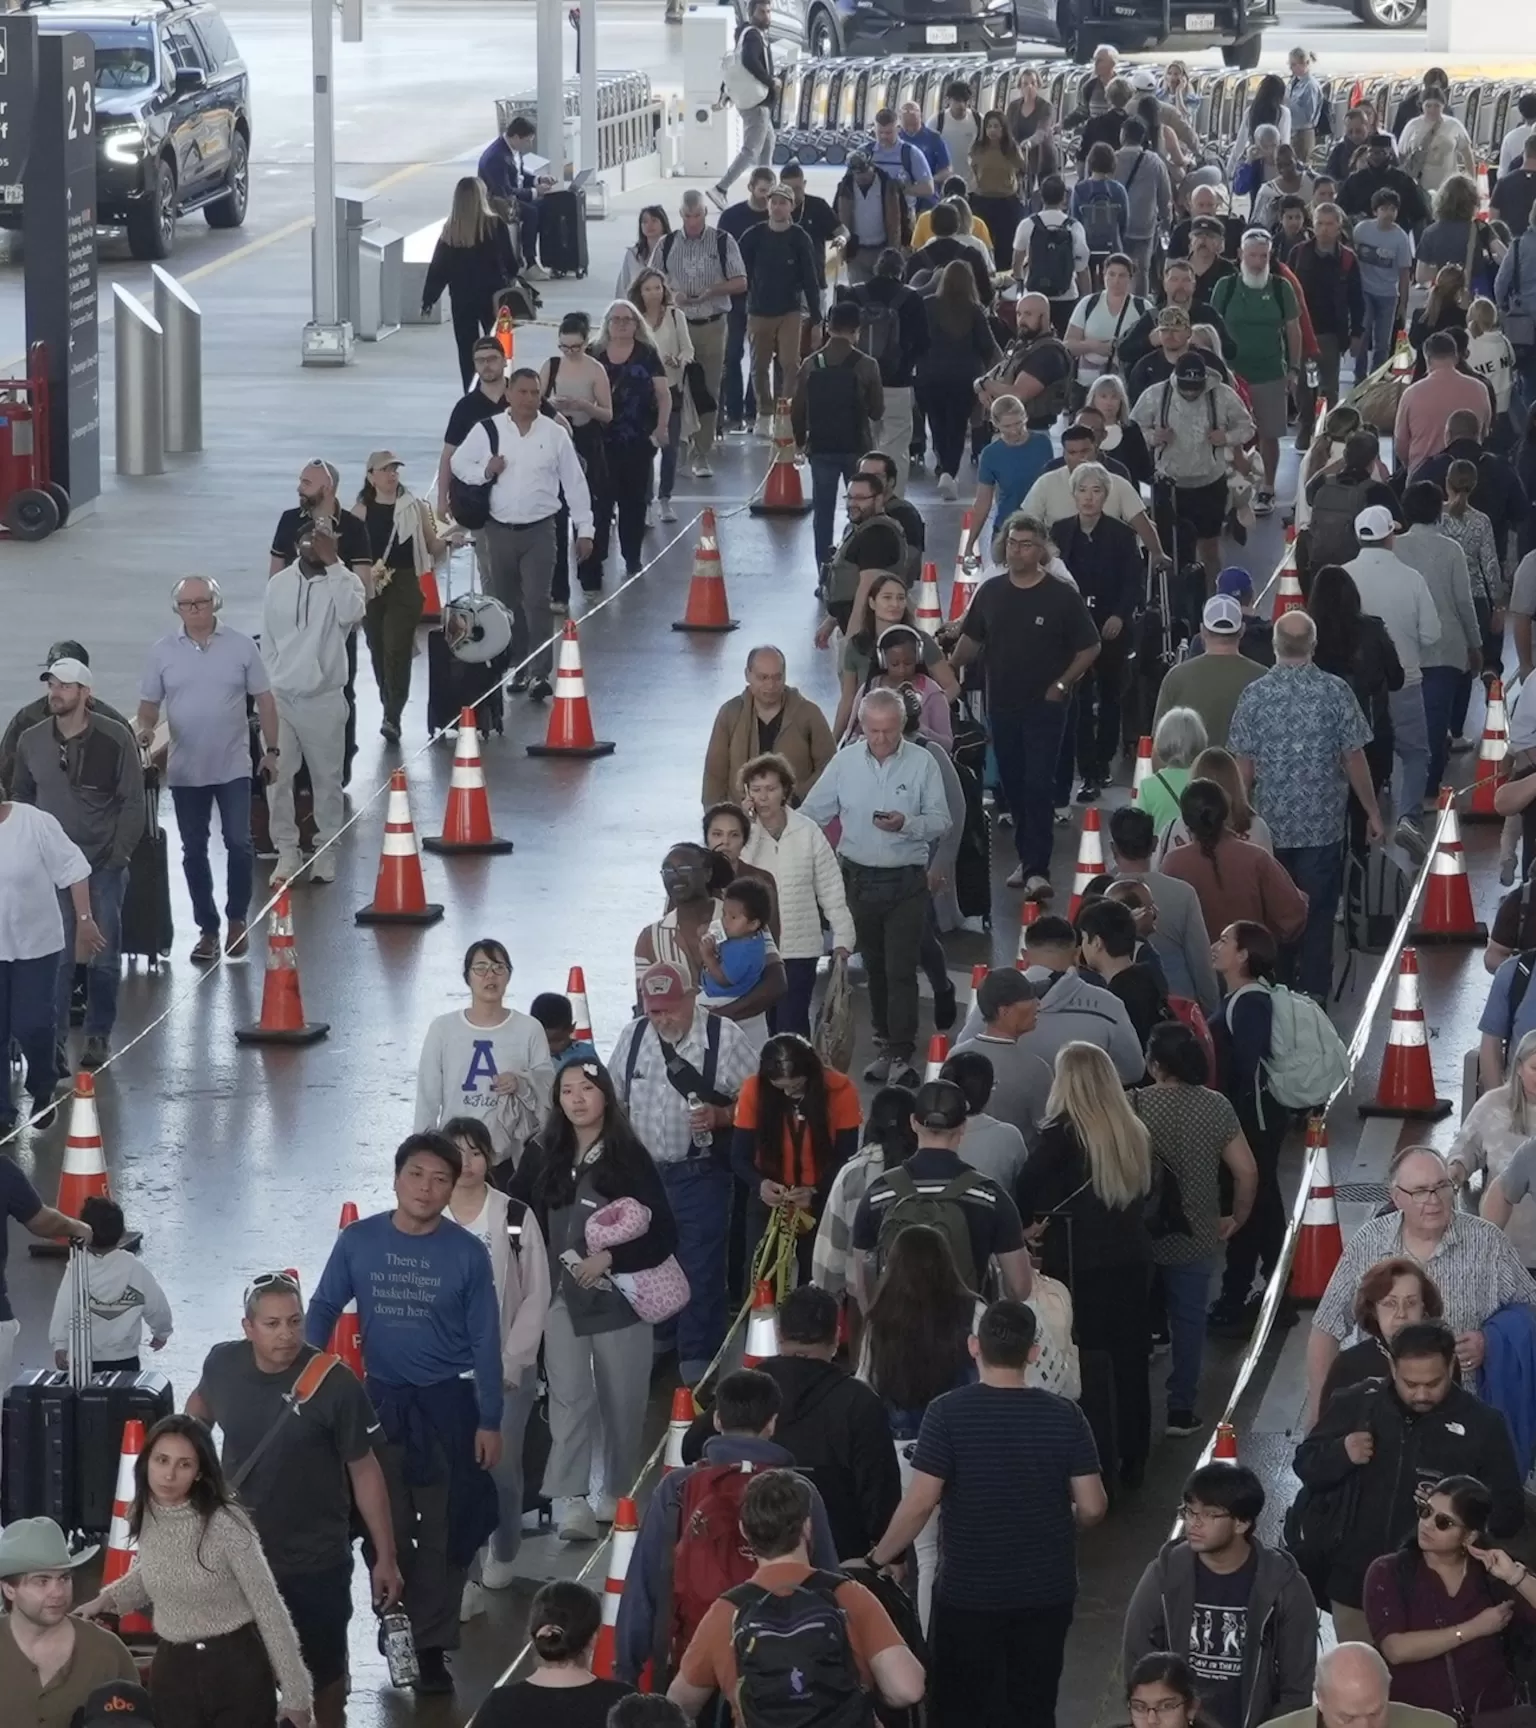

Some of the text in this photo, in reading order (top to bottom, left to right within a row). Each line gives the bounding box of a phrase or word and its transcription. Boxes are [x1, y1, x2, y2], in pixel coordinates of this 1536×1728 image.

[67, 81, 93, 140] 2 3
[461, 1040, 500, 1092] A
[385, 1252, 431, 1269] There is
[369, 1271, 442, 1288] no intelligent
[372, 1285, 437, 1303] basketballer
[374, 1303, 405, 1317] down
